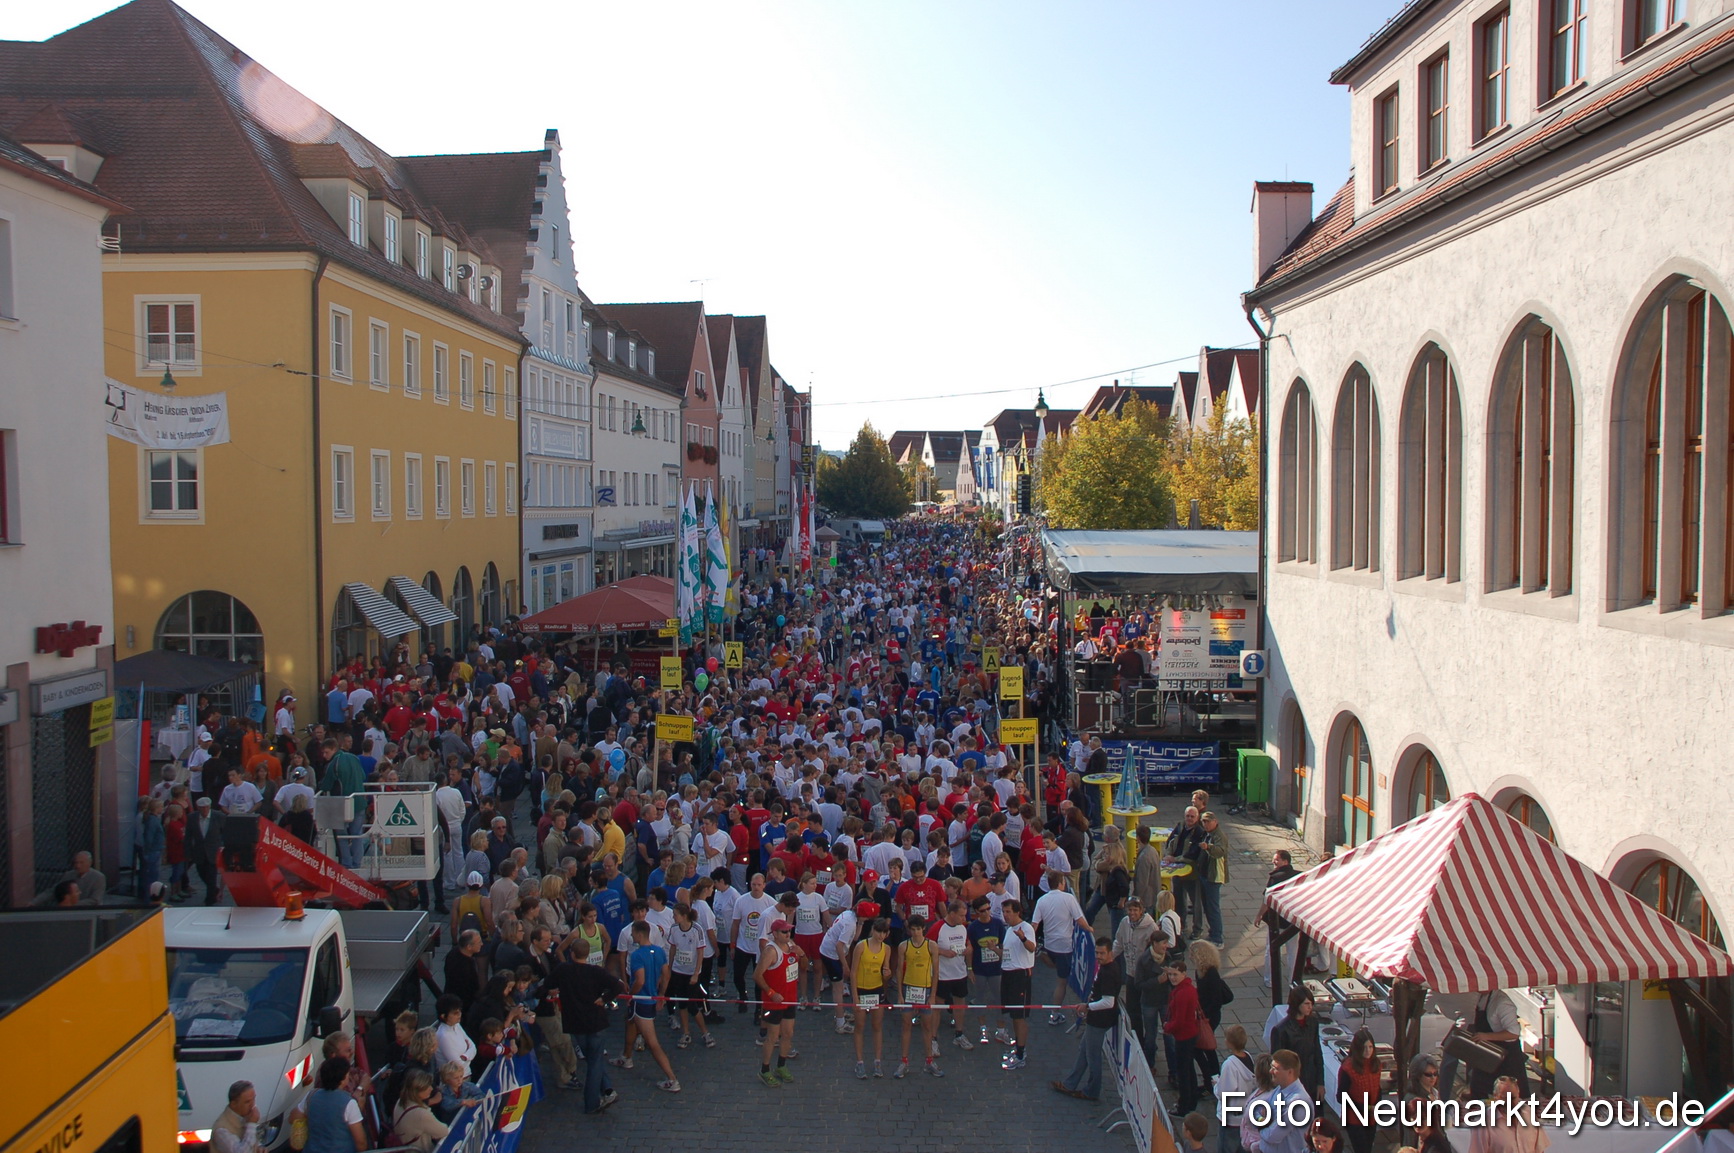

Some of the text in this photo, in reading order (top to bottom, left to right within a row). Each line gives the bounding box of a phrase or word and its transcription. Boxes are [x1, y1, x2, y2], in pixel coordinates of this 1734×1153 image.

[728, 650, 738, 662] A
[986, 654, 996, 667] A
[44, 693, 56, 702] BABY
[64, 682, 104, 696] KINDERMODEN
[659, 721, 690, 730] Schnupper-
[1131, 746, 1214, 757] THUNDER
[271, 833, 320, 870] Jura Gebäude Service
